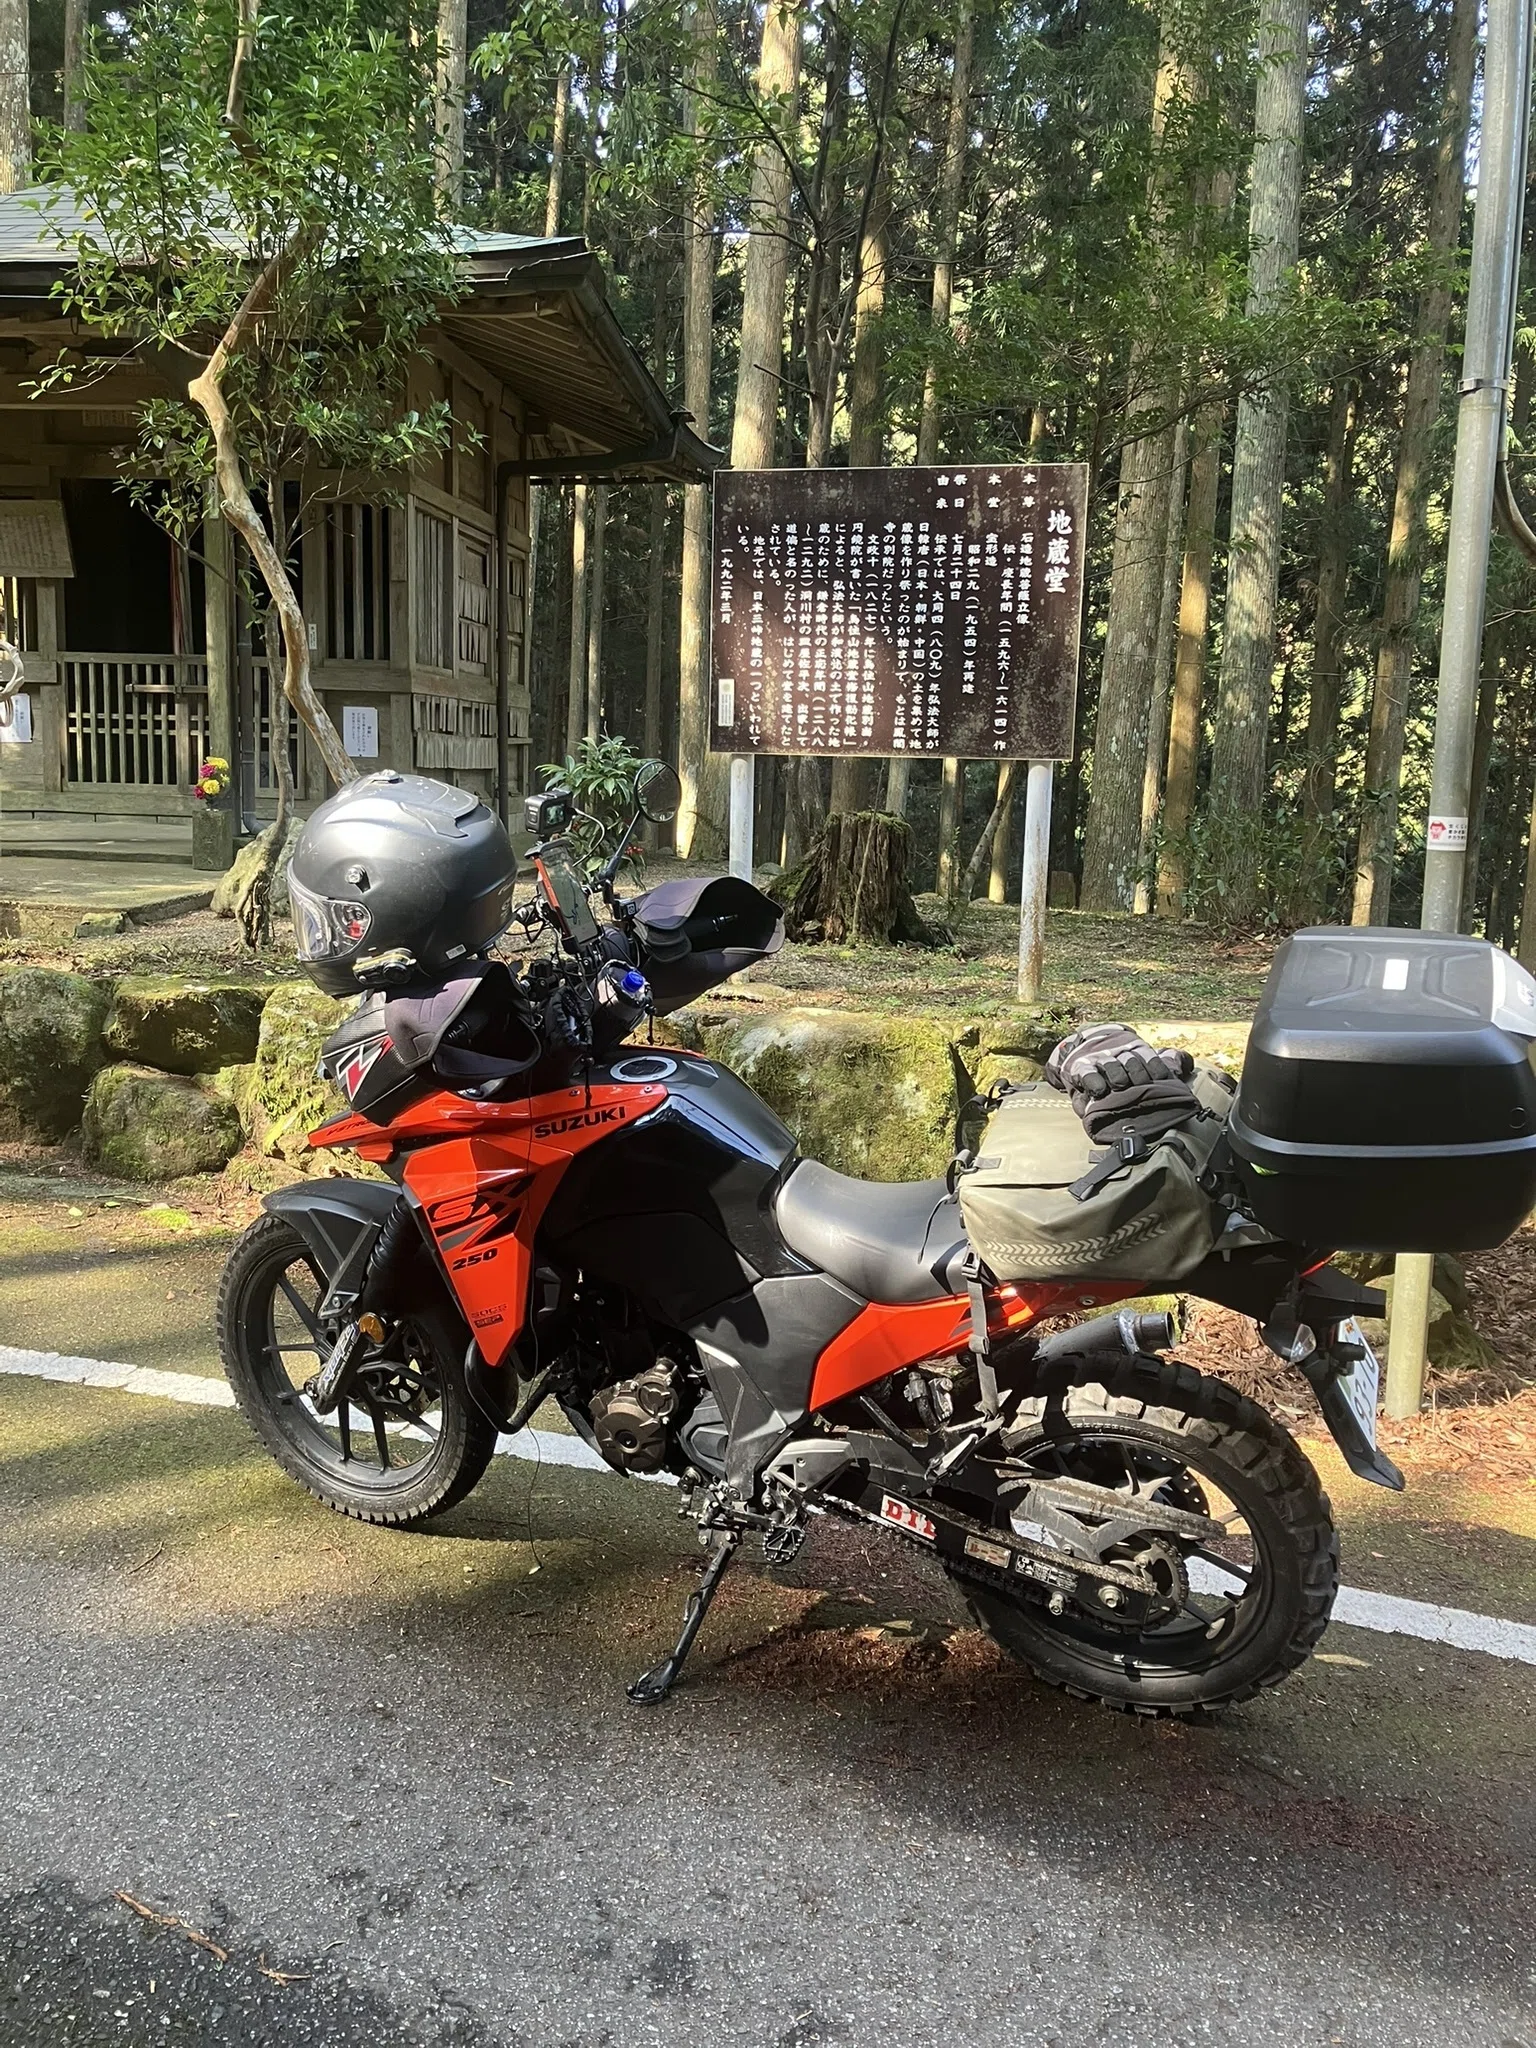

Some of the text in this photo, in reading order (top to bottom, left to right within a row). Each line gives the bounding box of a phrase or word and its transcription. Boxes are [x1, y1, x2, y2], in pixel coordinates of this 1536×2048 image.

[936, 474, 950, 509] 由来
[987, 473, 1002, 508] 本堂
[737, 525, 750, 553] いる。
[768, 523, 782, 586] されている。
[949, 474, 968, 601] 祭日 七月二十四日
[1016, 472, 1037, 625] 本尊 石造地蔵菩薩立像
[1044, 508, 1072, 594] 地蔵堂
[720, 548, 734, 625] 一九九二年三月
[962, 544, 981, 694] 昭和二九（一九五四）年再建
[535, 1106, 626, 1139] SUZUKI
[452, 1248, 498, 1271] 250
